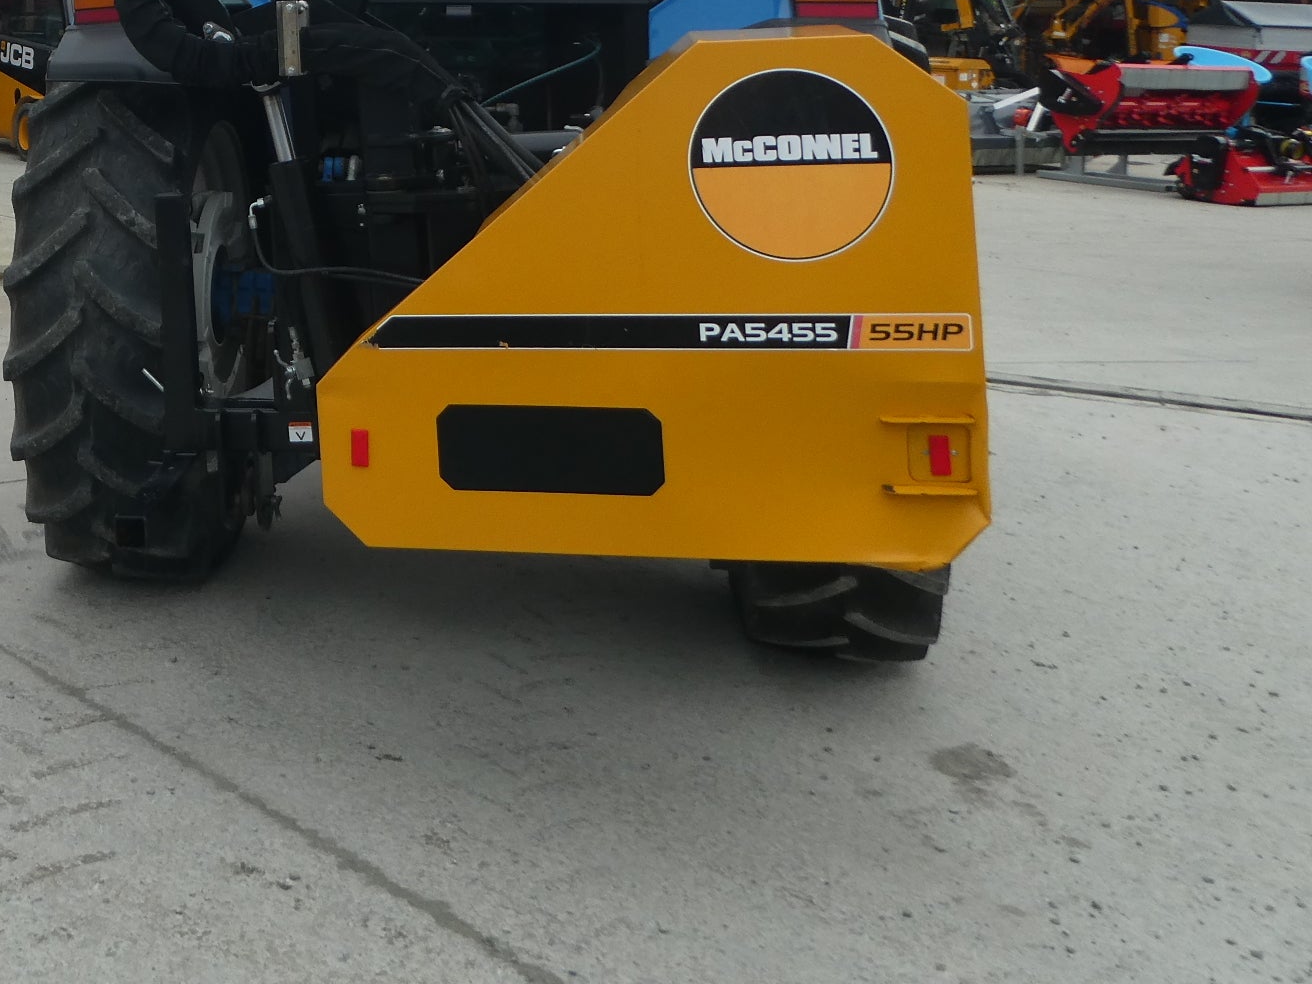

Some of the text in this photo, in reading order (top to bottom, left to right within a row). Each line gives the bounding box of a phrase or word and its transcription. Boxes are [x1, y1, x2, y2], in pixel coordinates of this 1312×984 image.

[0, 40, 35, 70] JCB
[701, 132, 879, 164] McCONNEL
[698, 322, 965, 342] PA5455 55HP
